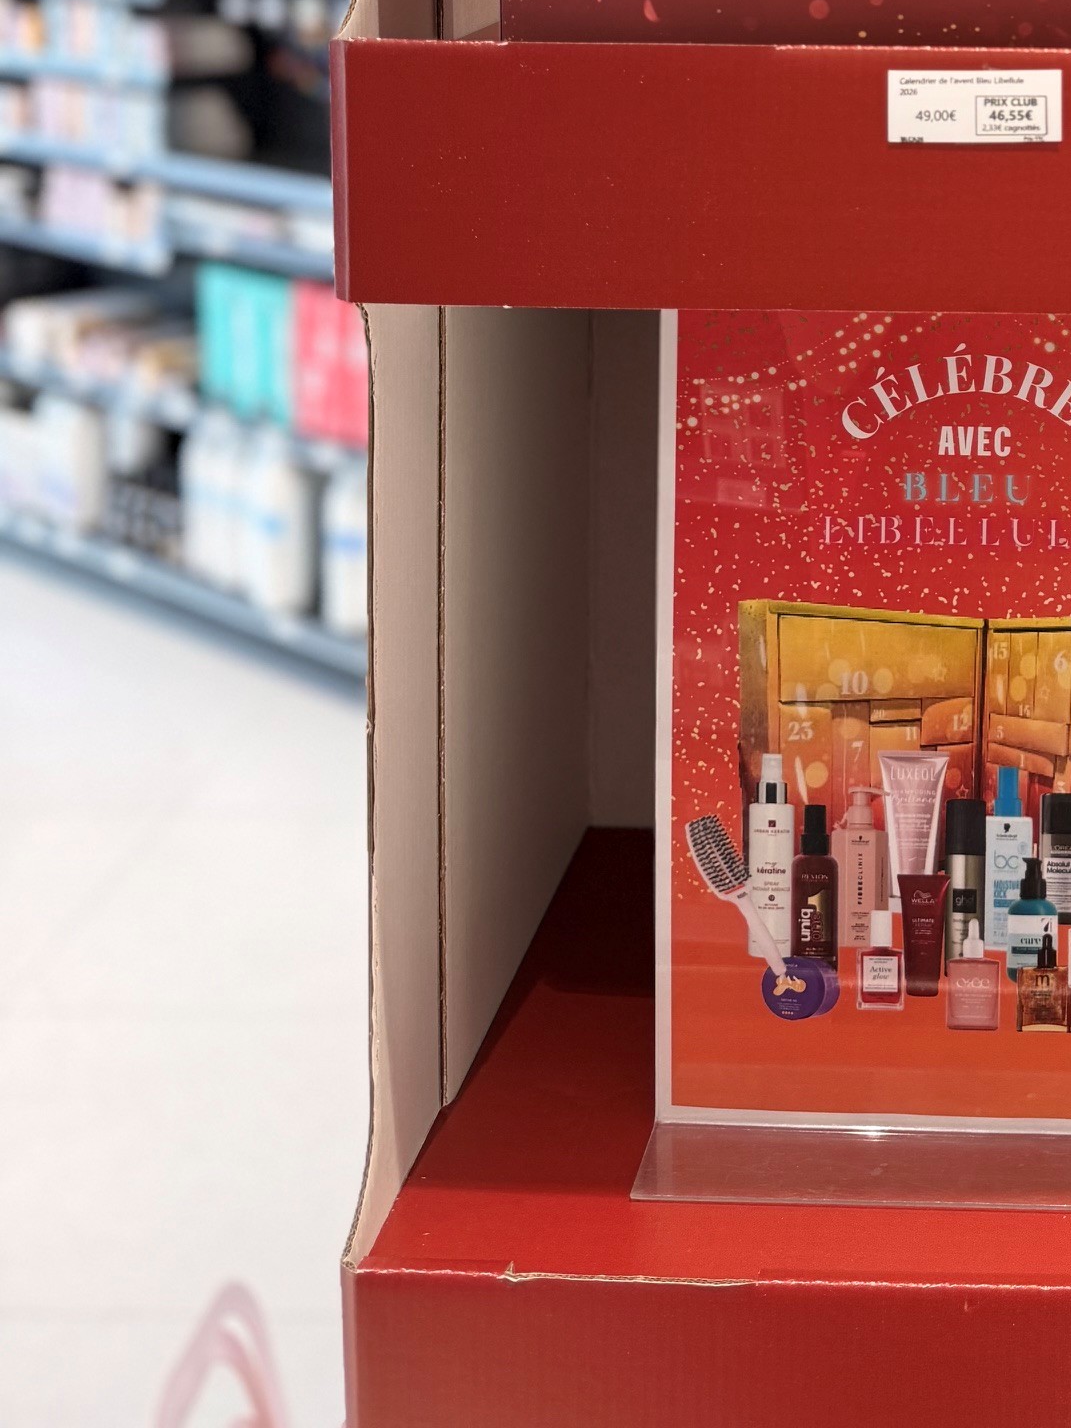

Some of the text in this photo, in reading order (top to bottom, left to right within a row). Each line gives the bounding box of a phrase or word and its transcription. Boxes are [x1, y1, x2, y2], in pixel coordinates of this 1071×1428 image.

[899, 77, 936, 85] Calendrier
[984, 98, 1038, 107] PRIX CLUB
[915, 109, 957, 123] 49,00€
[989, 109, 1033, 123] 46,55€
[938, 425, 1012, 458] AVEC
[903, 471, 1032, 504] BLEU
[840, 670, 869, 696] 10
[852, 740, 865, 763] 7
[756, 866, 787, 875] kératine
